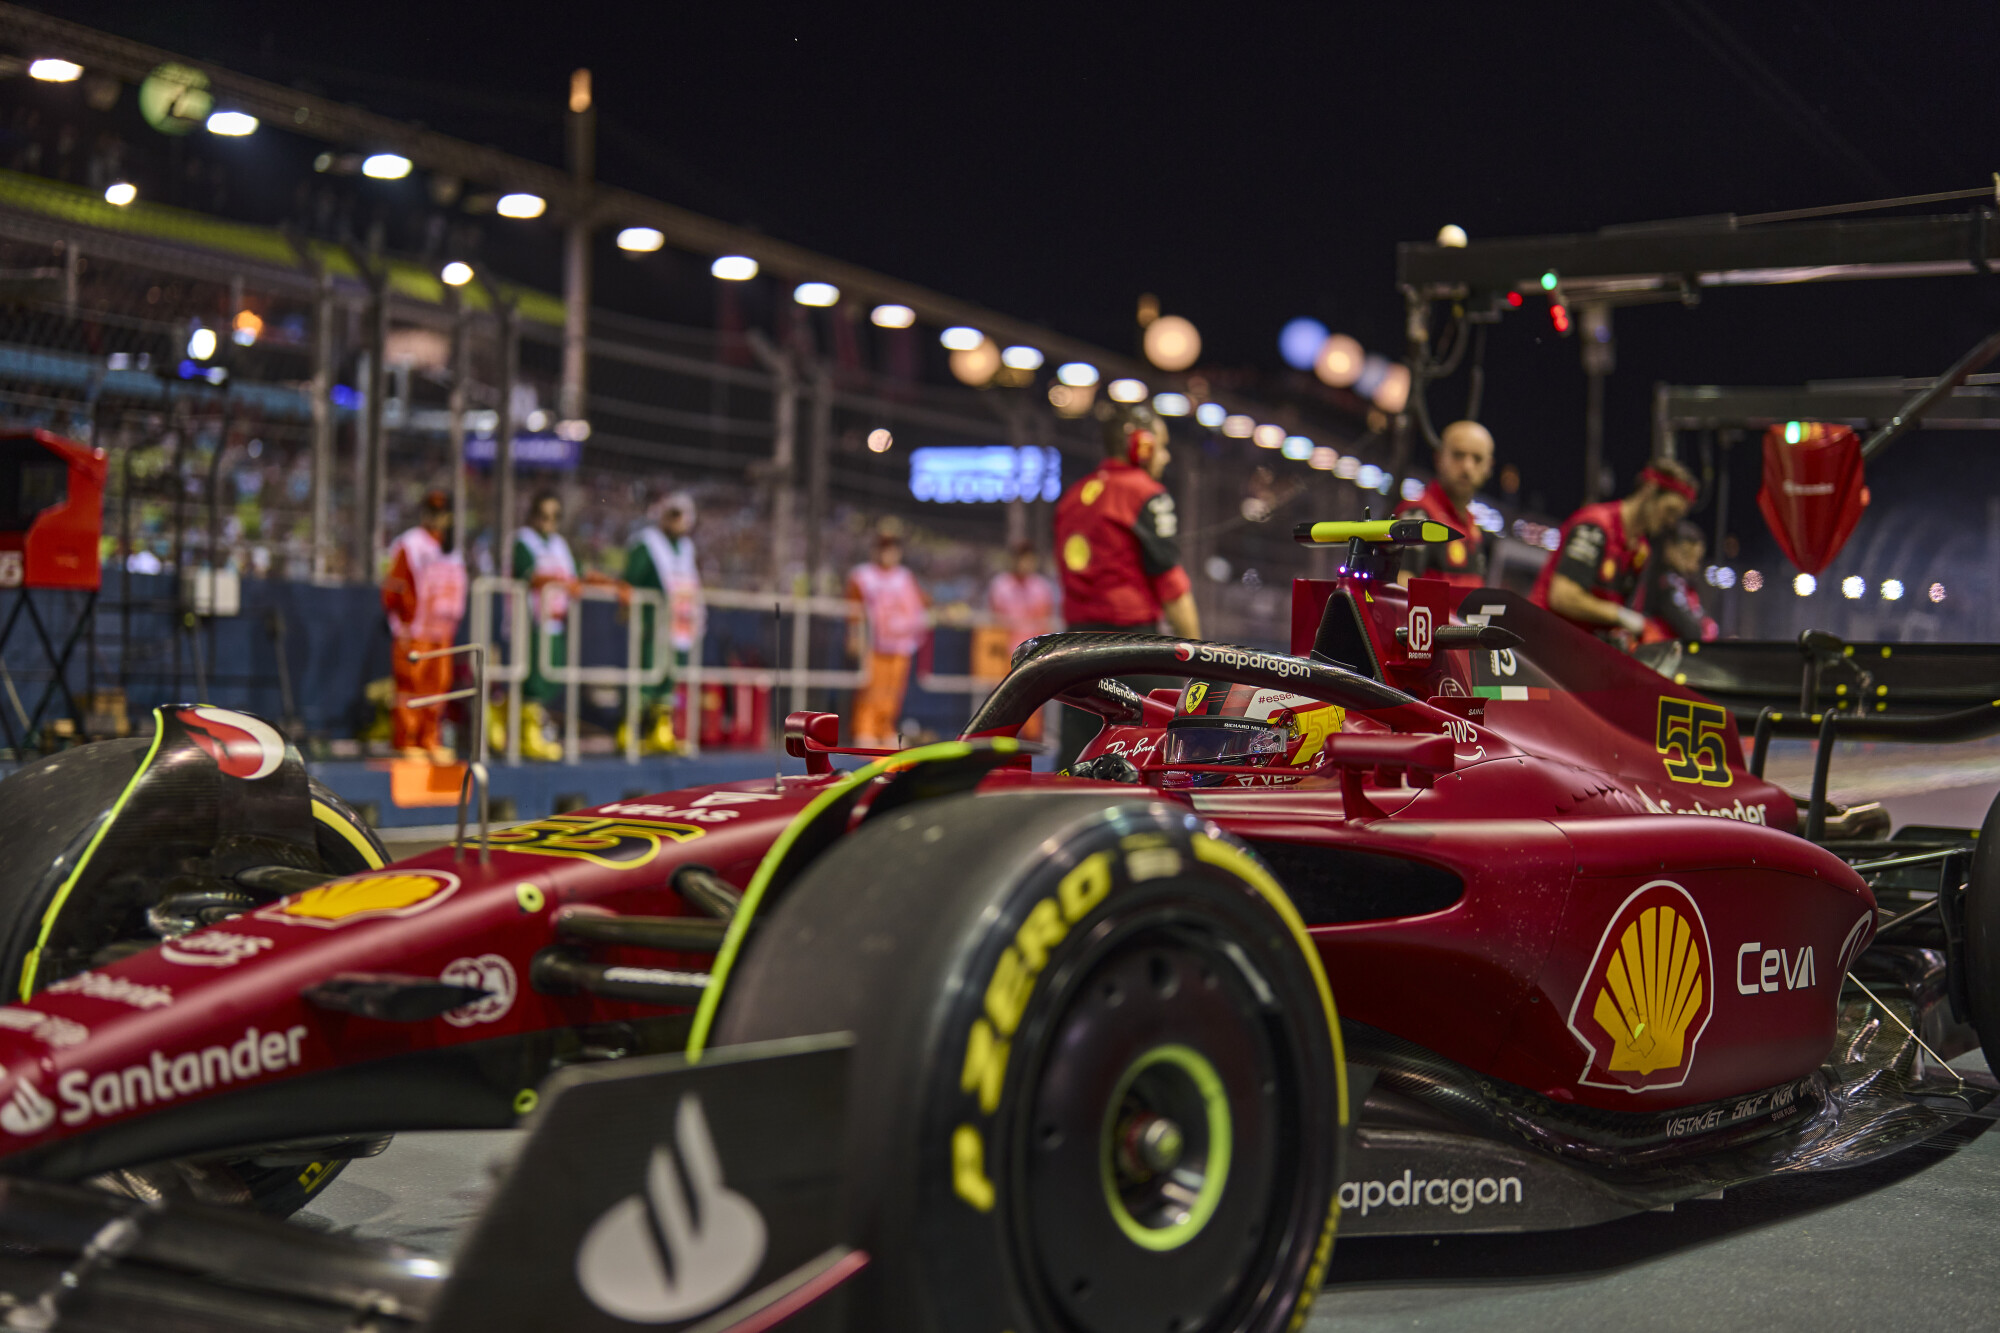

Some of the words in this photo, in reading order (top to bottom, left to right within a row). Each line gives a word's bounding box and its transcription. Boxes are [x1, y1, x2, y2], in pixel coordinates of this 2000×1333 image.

[1200, 646, 1311, 678] Snapdragon
[1258, 692, 1302, 704] #esser
[1655, 695, 1733, 787] 55
[57, 1026, 308, 1125] Santander
[1666, 1109, 1725, 1137] VISTAJET
[1731, 1094, 1768, 1120] SKF
[1770, 1084, 1797, 1110] NGK
[1338, 1169, 1522, 1216] apdragon
